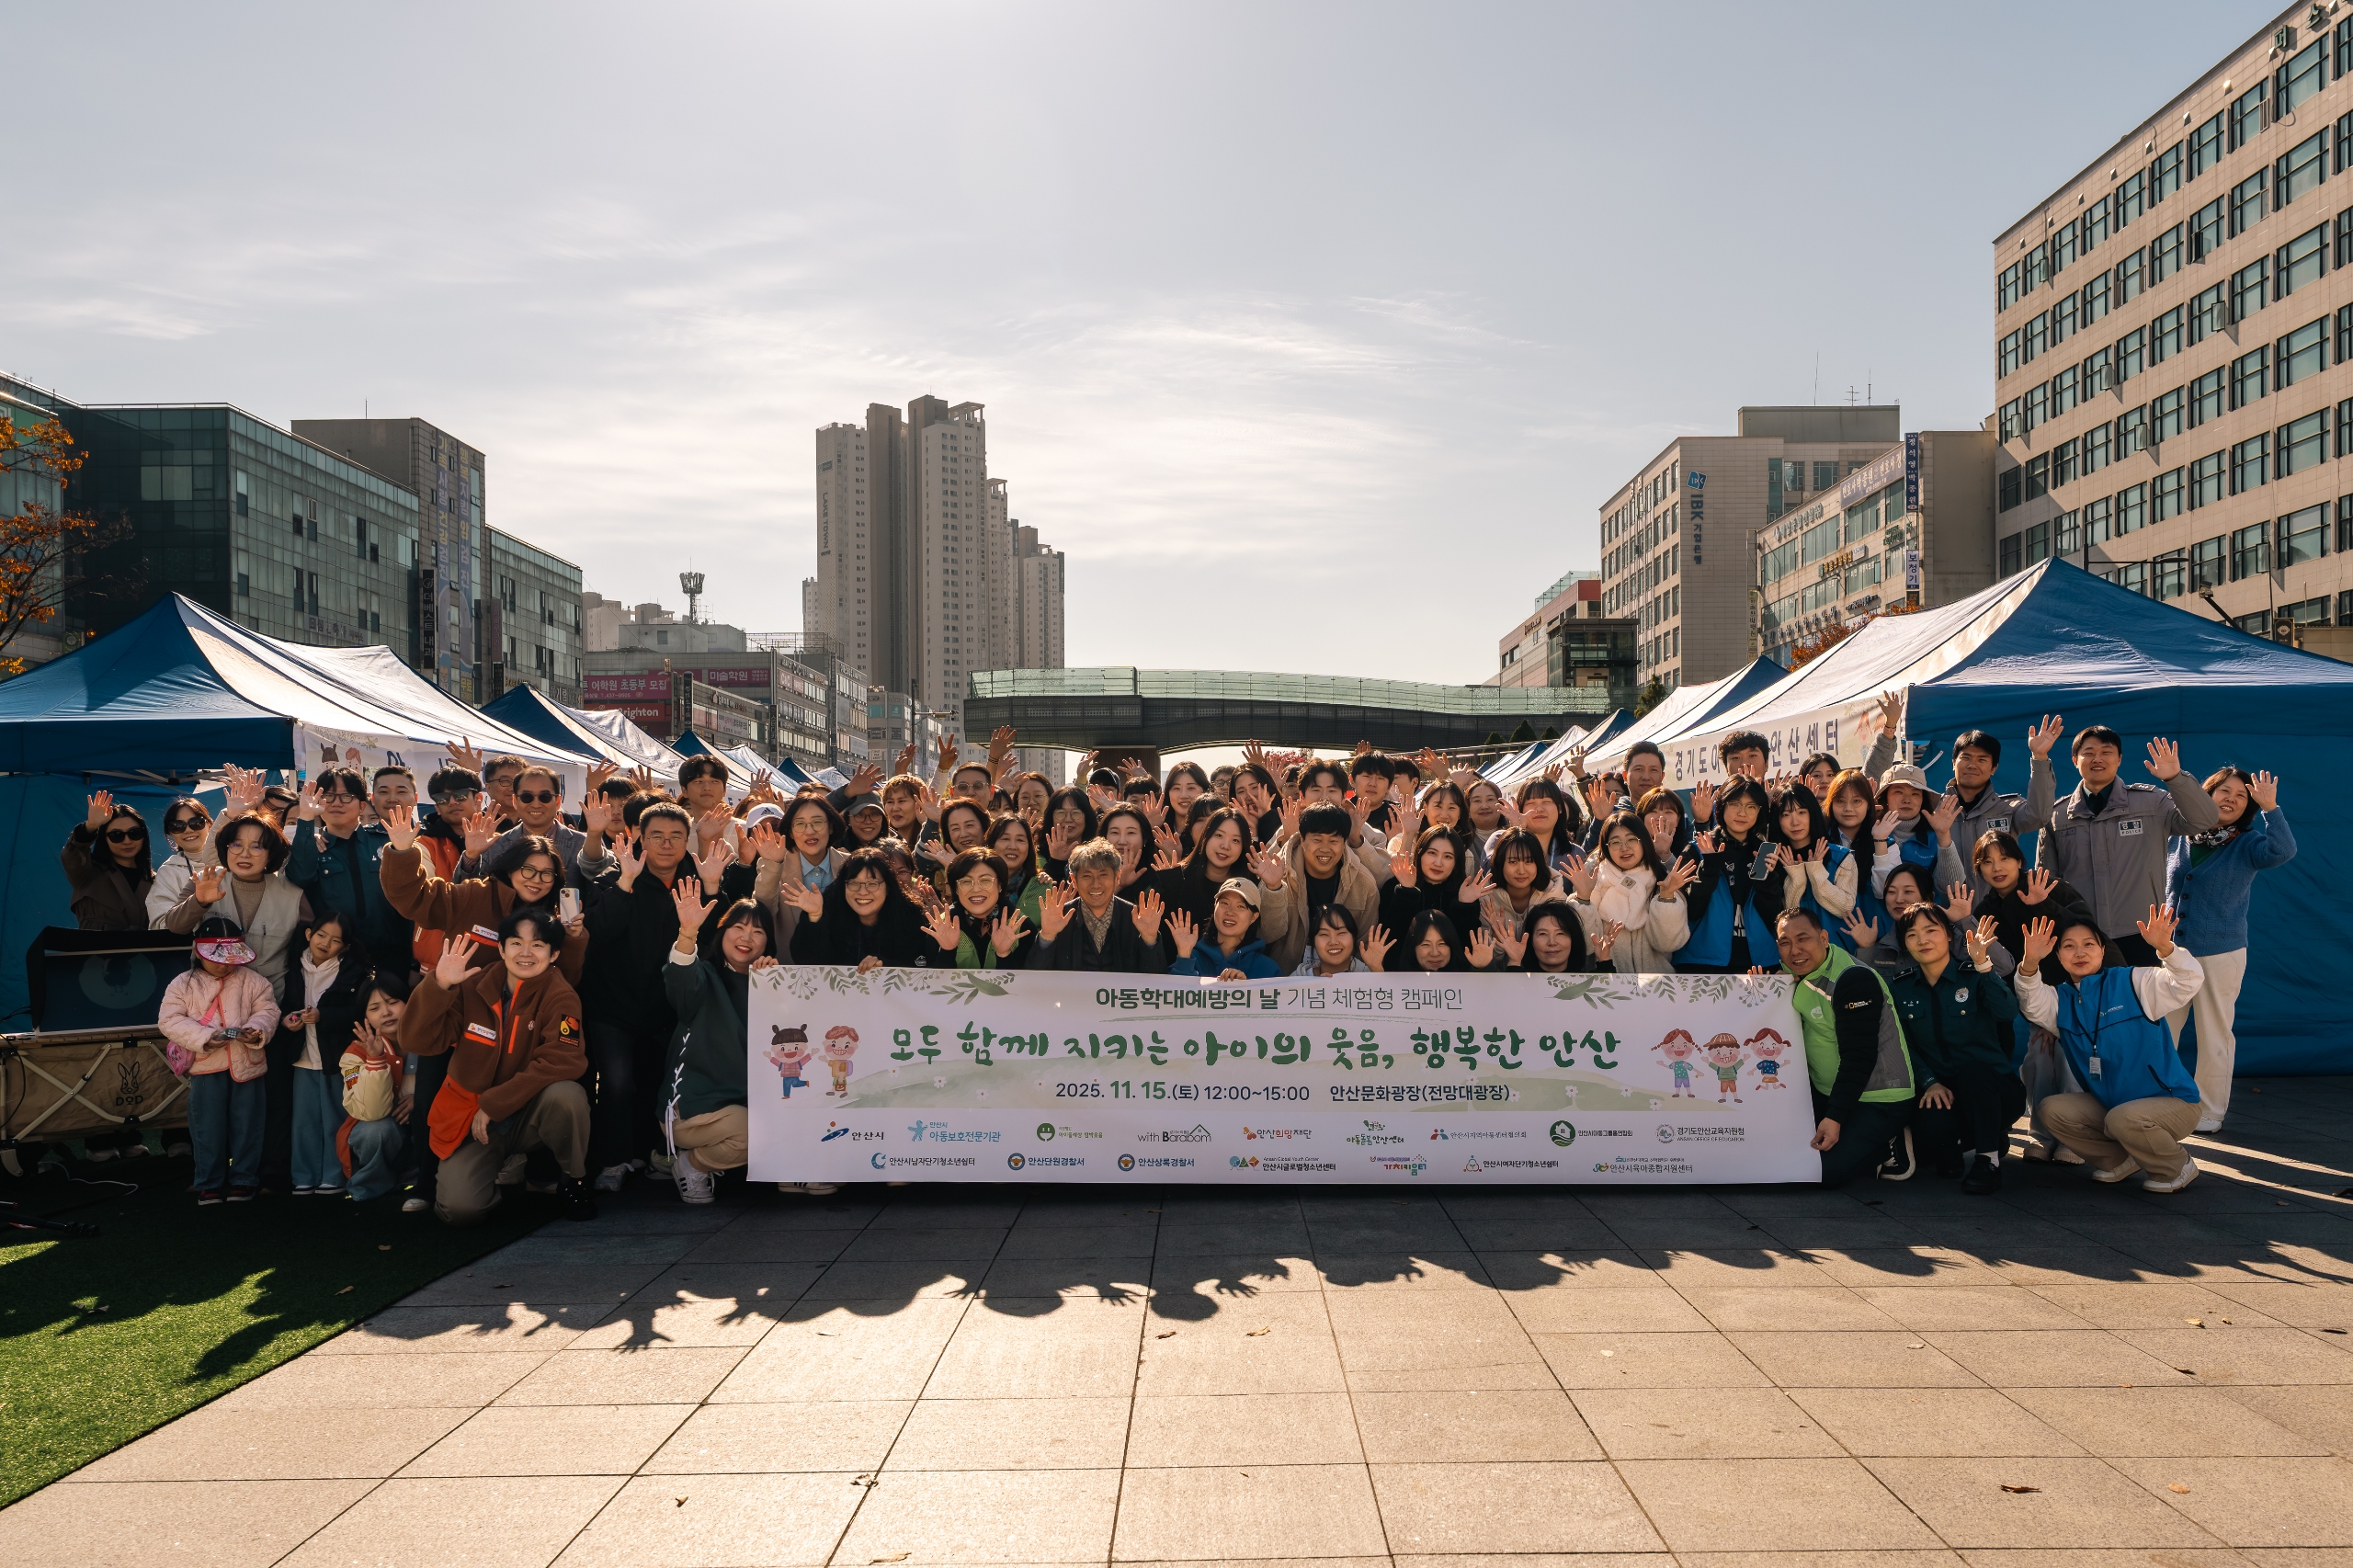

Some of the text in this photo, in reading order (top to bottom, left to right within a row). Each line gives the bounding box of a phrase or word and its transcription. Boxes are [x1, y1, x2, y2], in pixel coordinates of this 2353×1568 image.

[438, 434, 449, 582] 가족사랑 건강검진
[1690, 494, 1704, 521] IBK
[1693, 523, 1702, 565] 기업은행
[1908, 553, 1917, 584] 보청기
[423, 592, 436, 658] 더베스트 내과
[710, 671, 748, 682] 미술학원
[591, 680, 618, 691] 어학원
[620, 679, 647, 691] 초등부
[649, 680, 667, 691] 모집
[619, 708, 659, 720] righton
[1096, 987, 1462, 1010] 아동학대예방의 날 기념 체험형 캠페인
[890, 1020, 1621, 1072] 모두 함께 지키는 아이의 웃음, 행복한 안산
[1056, 1083, 1105, 1098] 2025.
[1330, 1085, 1510, 1103] 안산문화광장(전망대광장)
[851, 1131, 884, 1142] 안산시
[929, 1131, 1002, 1142] 아동보호전문기관
[1137, 1131, 1160, 1142] with
[1163, 1131, 1211, 1142] Barabom
[1256, 1129, 1313, 1140] 안산희망재단
[1677, 1127, 1745, 1137] 경기도안산교육지원청
[889, 1156, 975, 1166] 안산시남자단기청소년쉼터
[1028, 1156, 1085, 1166] 안산단원경찰서
[1138, 1157, 1195, 1167] 안산상록경찰서
[1483, 1160, 1559, 1168] 안산시여자단기청소년쉼터
[1262, 1162, 1336, 1172] 안산시글로벌청소년센터
[1609, 1164, 1693, 1174] 안산시육아종합지원센터
